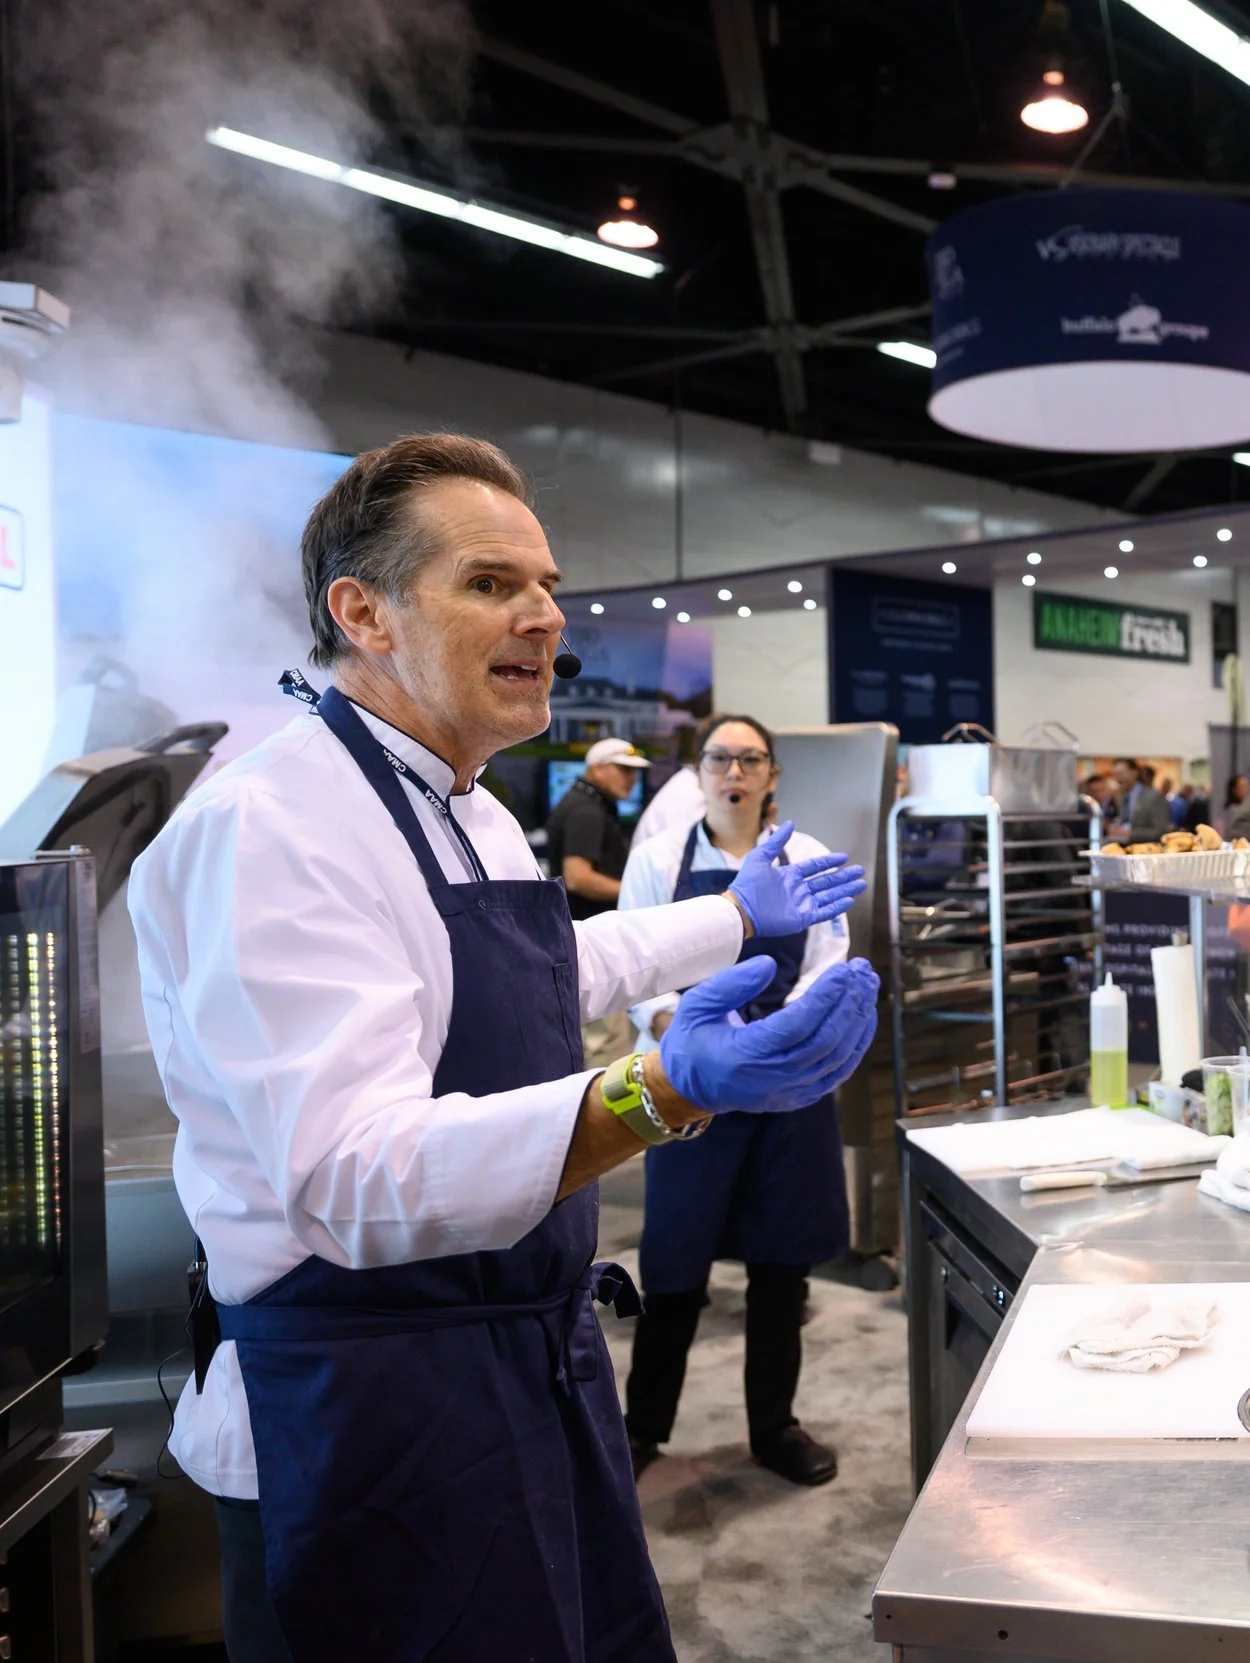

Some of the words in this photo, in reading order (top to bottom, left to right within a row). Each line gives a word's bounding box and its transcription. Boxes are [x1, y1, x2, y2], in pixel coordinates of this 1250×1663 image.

[1041, 602, 1120, 648] ANAHEIM
[1121, 611, 1187, 658] fresh
[425, 789, 448, 814] CMAA
